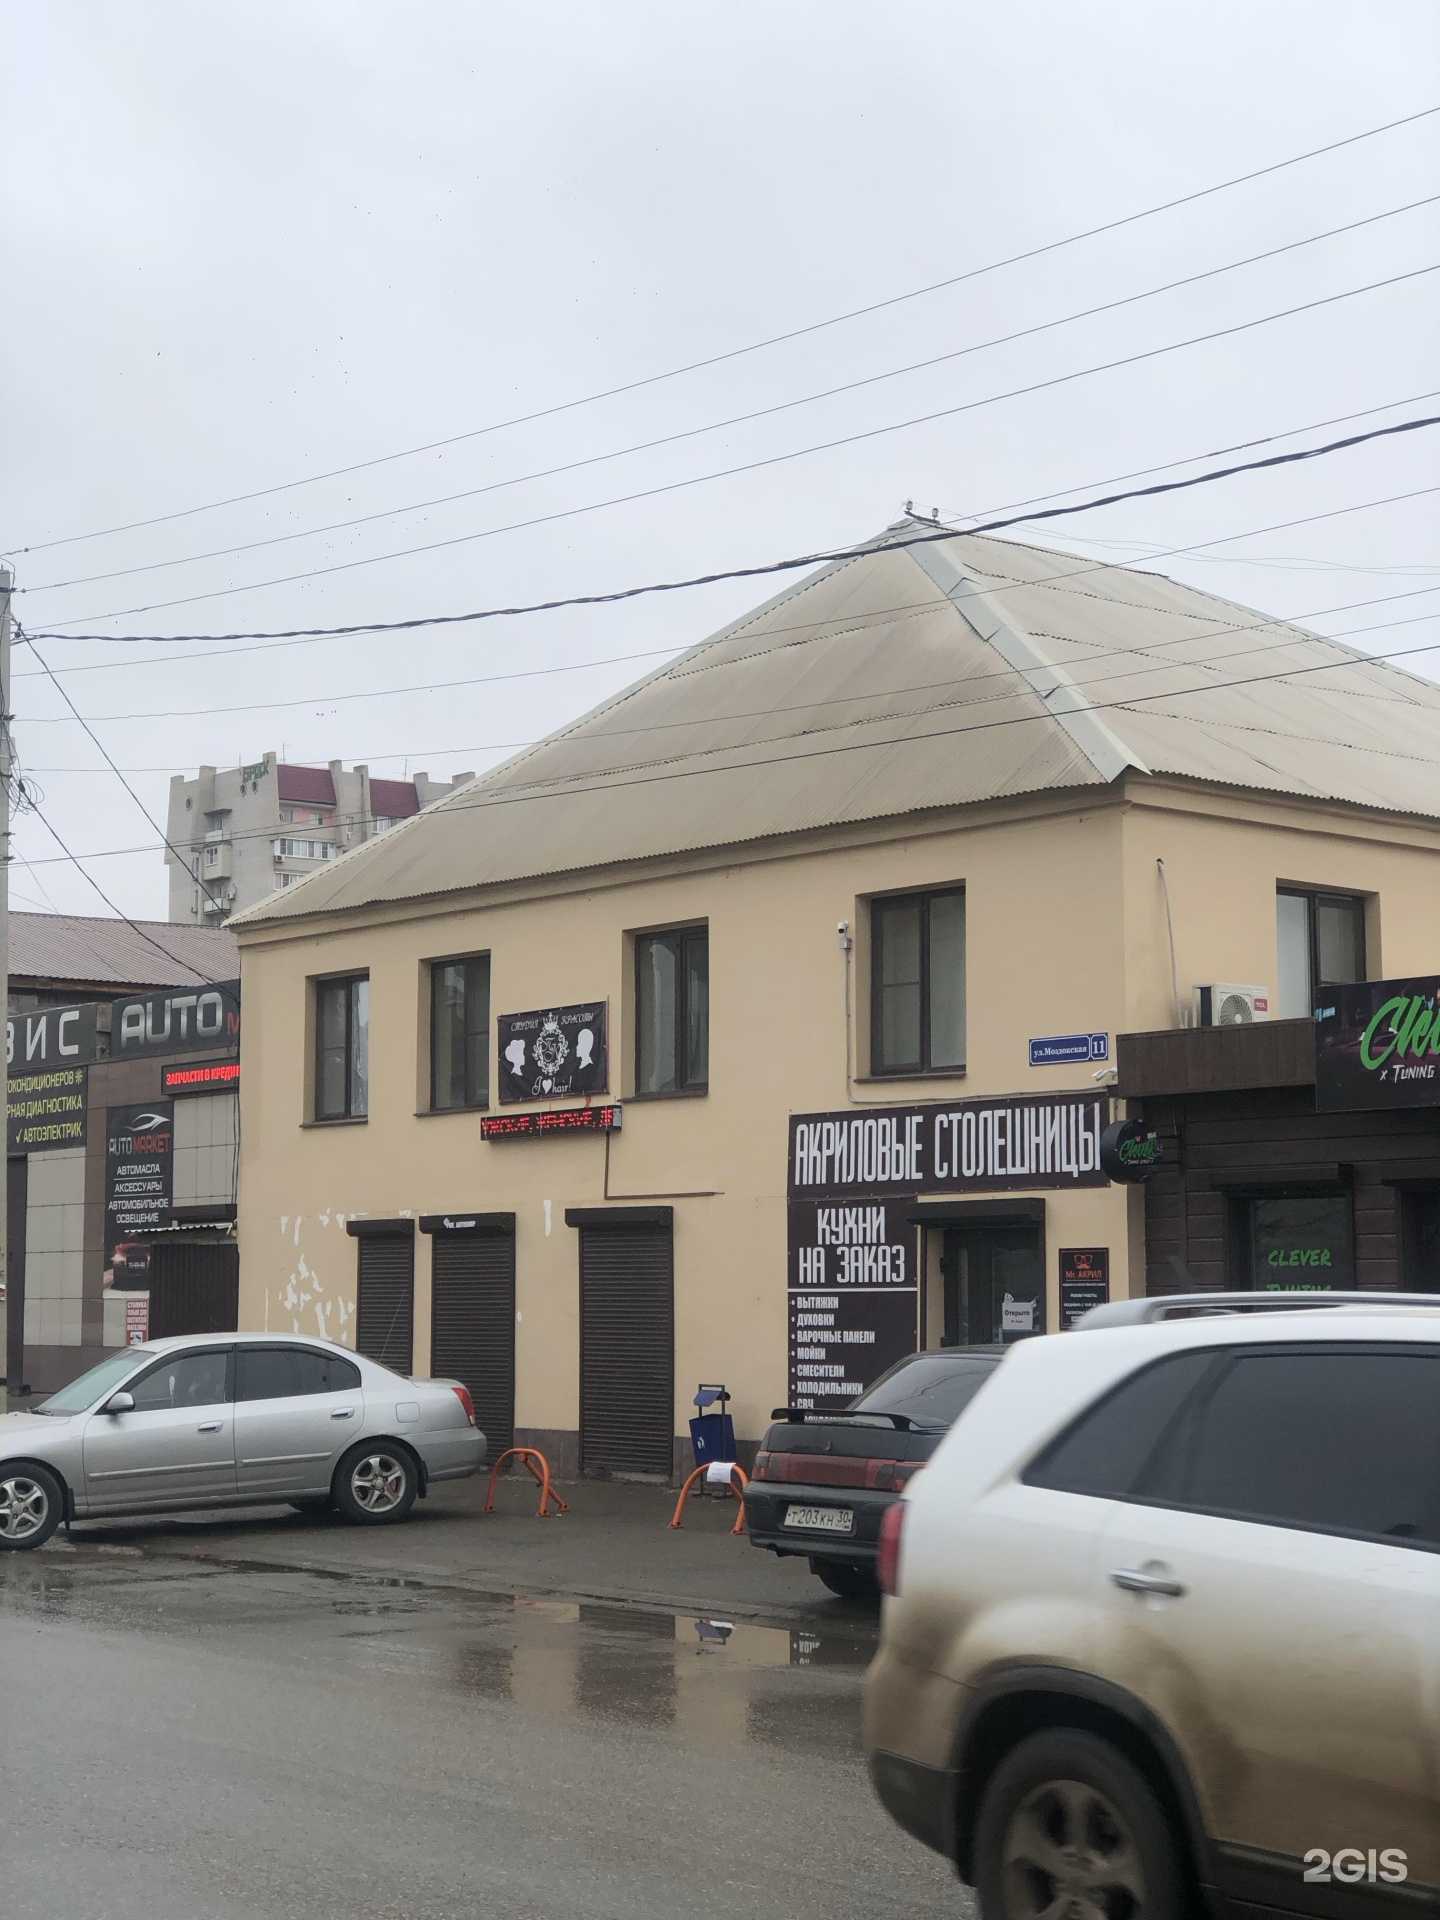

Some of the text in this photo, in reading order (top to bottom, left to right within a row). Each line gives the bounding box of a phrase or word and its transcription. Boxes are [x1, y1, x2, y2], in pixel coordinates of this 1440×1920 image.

[121, 993, 223, 1048] AUTO
[1093, 1040, 1106, 1054] 11
[26, 1095, 82, 1119] ДИАГНОСТИКА
[23, 1121, 82, 1143] АВТОЭЛЕКТРИК
[795, 1102, 1101, 1186] АКРИЛОВЫЕ СТОЛЕШНИЦЫ
[117, 1163, 160, 1176] АВТОМАСЛА
[114, 1181, 163, 1193] АКСЕССУАРЫ
[108, 1198, 169, 1210] АВТОМОБИЛЬНОЕ
[115, 1212, 159, 1224] ОСВЕЩЕНИЕ
[817, 1206, 885, 1245] КУХНИ
[799, 1245, 905, 1284] НА ЗАКАЗ
[1268, 1248, 1332, 1267] CLEVER
[797, 1296, 839, 1309] ВЫТЯЖКИ
[797, 1313, 835, 1327] ДУХОВКИ
[797, 1330, 875, 1344] ВАРОЧНЫЕ ПАНЕЛИ
[797, 1345, 826, 1360] МОЙКИ
[797, 1364, 845, 1378] СМЕСИТЕЛИ
[797, 1381, 864, 1396] ХОЛОДИЛЬНИКИ
[797, 1398, 814, 1409] СВЧ
